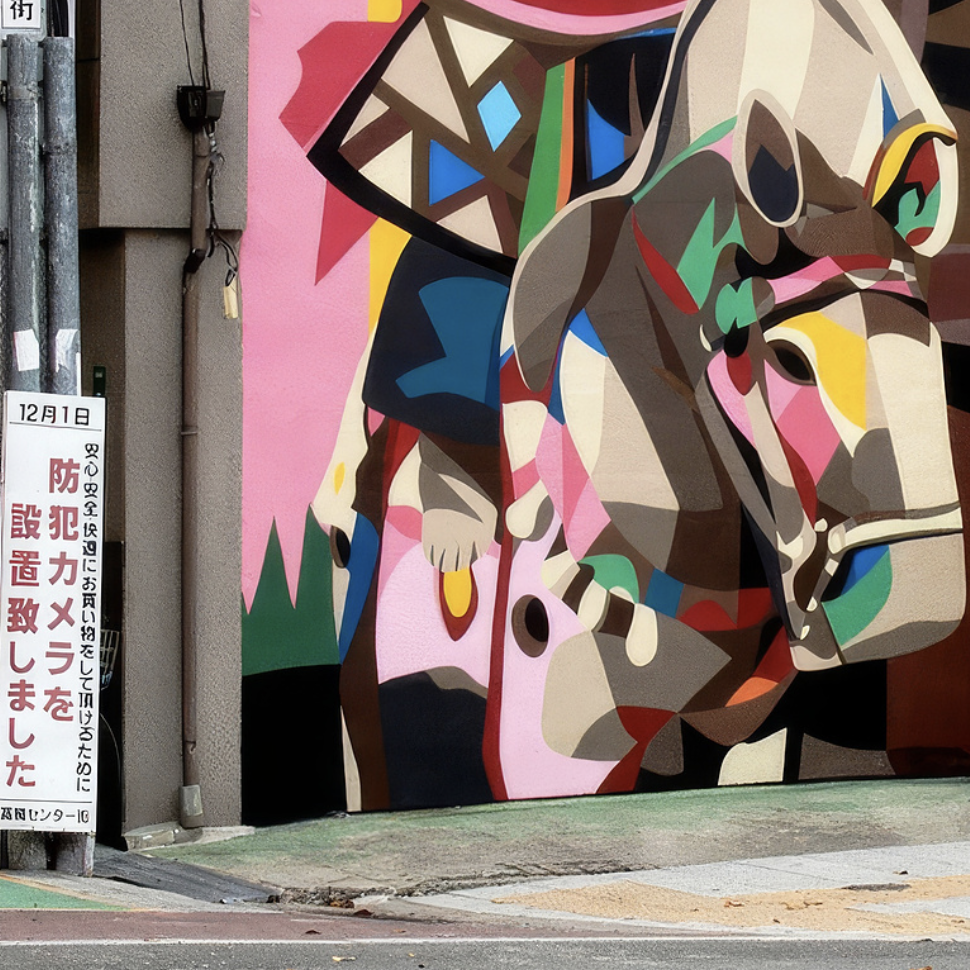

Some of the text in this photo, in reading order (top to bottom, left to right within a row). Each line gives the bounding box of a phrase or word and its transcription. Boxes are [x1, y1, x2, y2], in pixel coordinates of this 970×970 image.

[19, 403, 90, 426] 12月1日
[6, 502, 42, 787] 設置致しました
[43, 457, 80, 722] 防犯カメラを
